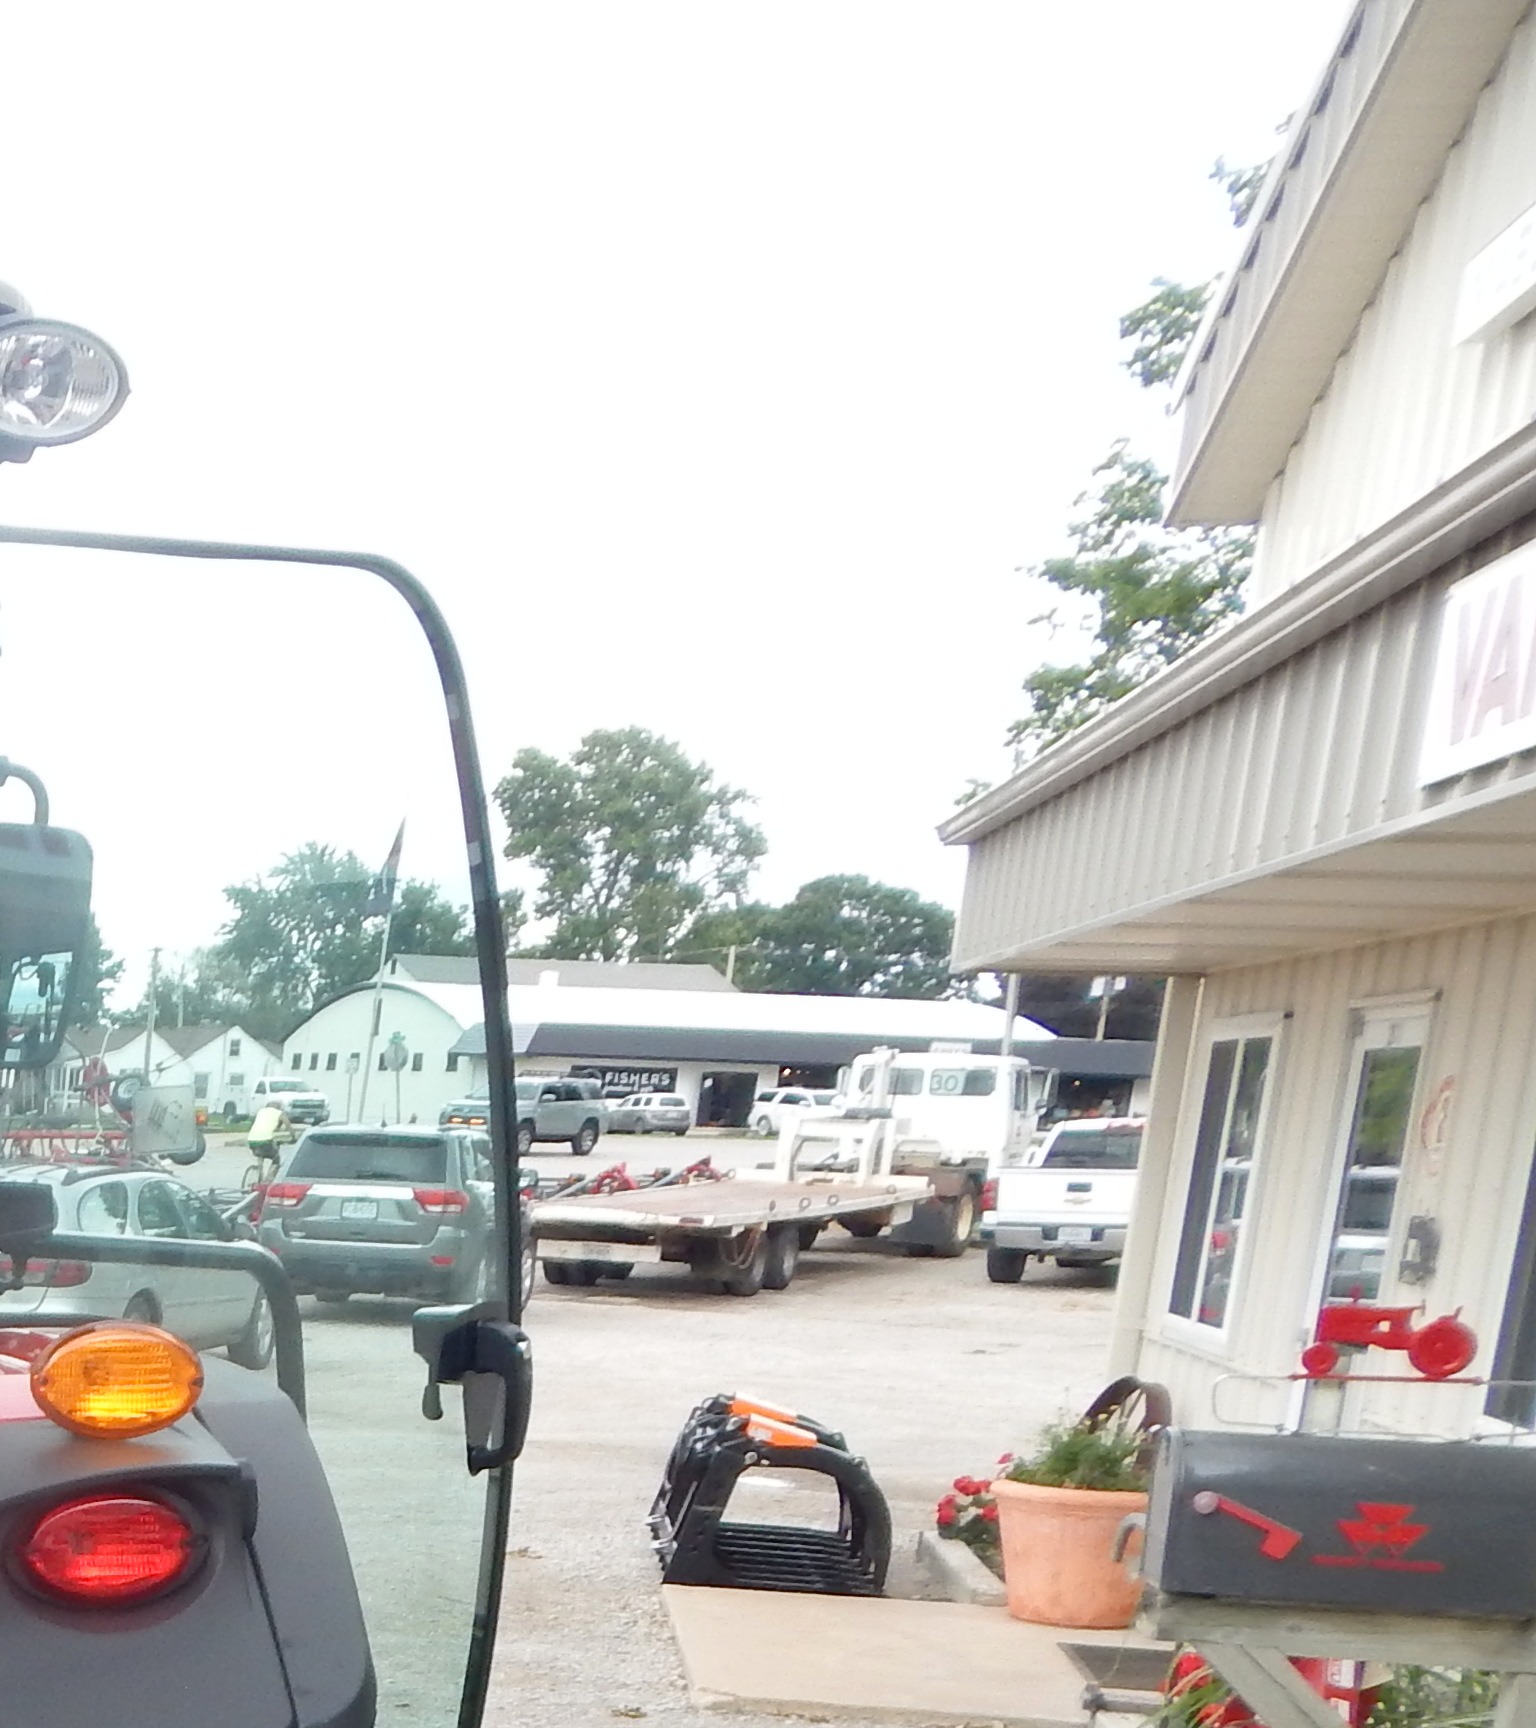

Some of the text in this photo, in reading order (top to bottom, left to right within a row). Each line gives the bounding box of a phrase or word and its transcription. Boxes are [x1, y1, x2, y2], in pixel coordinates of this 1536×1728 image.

[1449, 574, 1536, 746] VA
[605, 1071, 671, 1086] FISHER'S
[930, 1074, 959, 1092] 30
